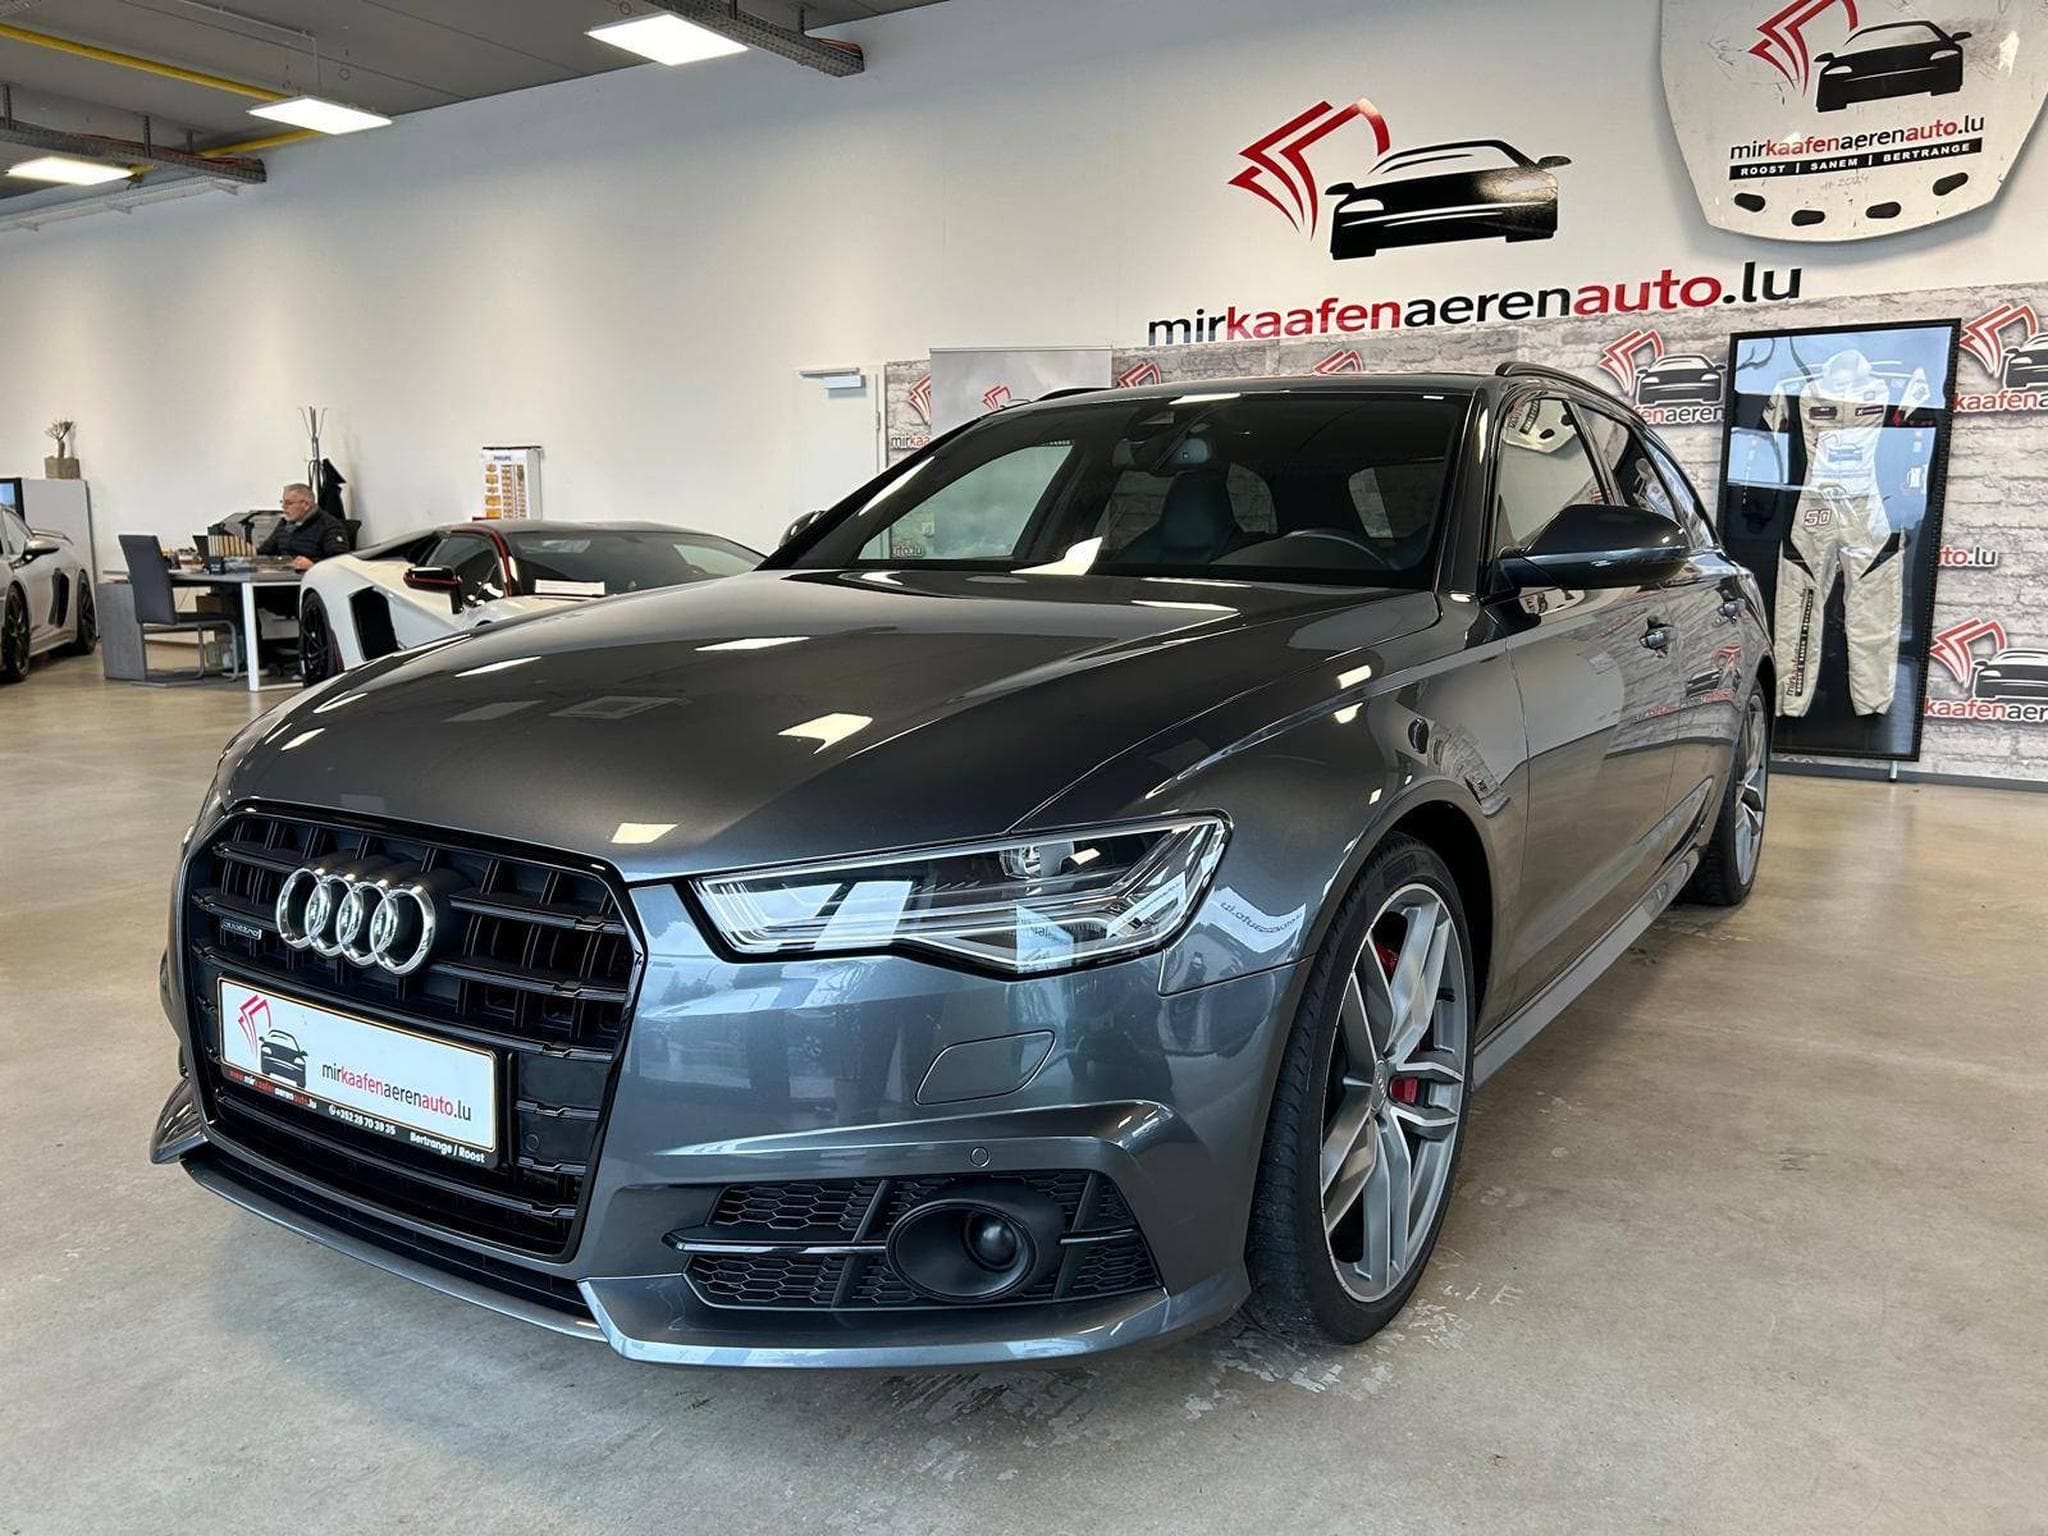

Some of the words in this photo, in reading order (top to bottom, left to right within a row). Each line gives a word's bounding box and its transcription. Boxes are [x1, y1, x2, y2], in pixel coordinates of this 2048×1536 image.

[1730, 115, 1984, 159] mirkaafenaerenauto.lu
[1741, 165, 1785, 177] ROOST
[1809, 159, 1859, 171] SANEM
[1882, 142, 1970, 163] BERTRANGE
[1148, 262, 1803, 346] mirkaafenaerenauto.lu
[1804, 509, 1832, 527] 50
[1939, 547, 1996, 564] to.lu
[322, 1063, 471, 1121] mirkaafenaerenauto.lu
[410, 1132, 453, 1155] Bertrange
[458, 1146, 485, 1163] Roost
